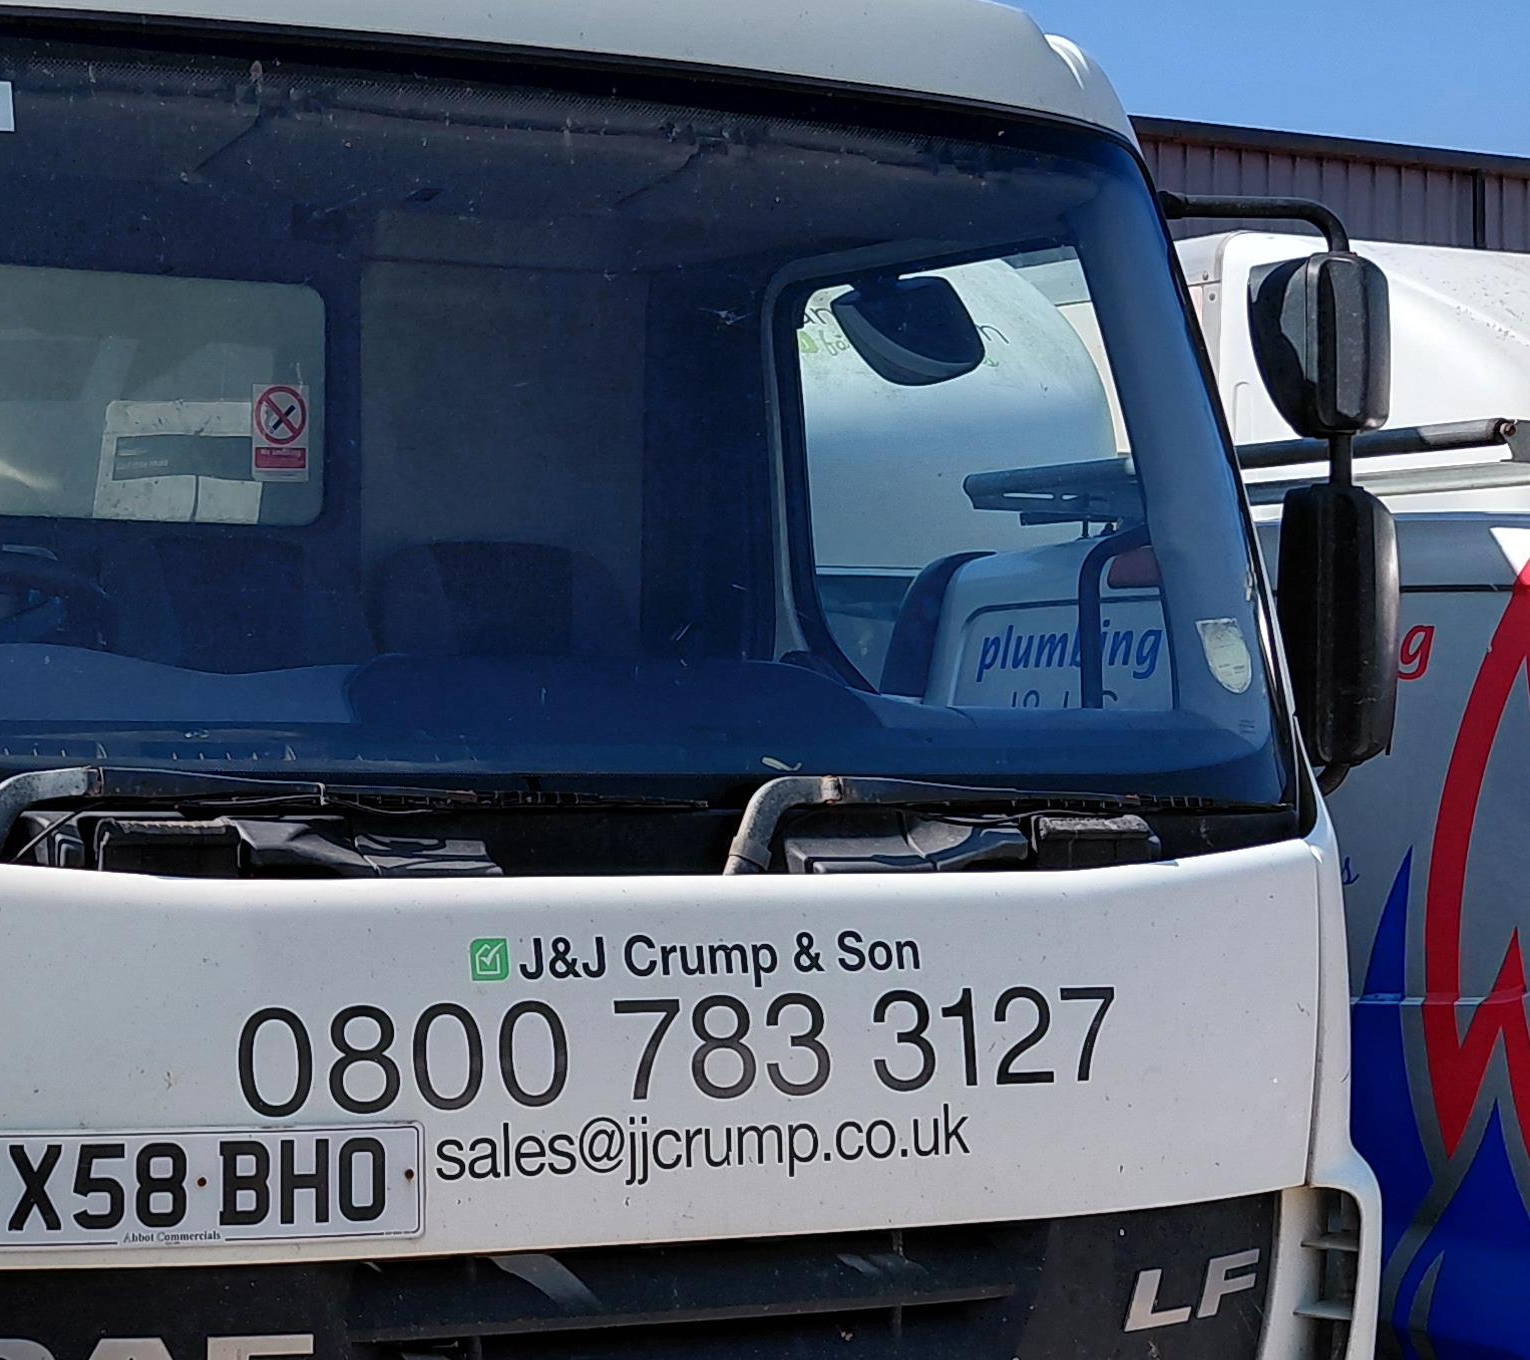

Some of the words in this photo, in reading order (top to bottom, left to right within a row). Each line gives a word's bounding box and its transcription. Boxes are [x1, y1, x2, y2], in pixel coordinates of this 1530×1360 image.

[519, 937, 605, 981] J&J
[623, 934, 778, 988] Crump
[793, 934, 826, 972] &
[837, 930, 921, 970] Son
[237, 1000, 570, 1117] 0800
[611, 992, 832, 1100] 783
[873, 986, 1117, 1092] 3127
[218, 1136, 386, 1226] BHO
[435, 1103, 969, 1187] sales@jjcrump.co.uk
[156, 1230, 221, 1243] Commercials
[1124, 1247, 1261, 1333] LF
